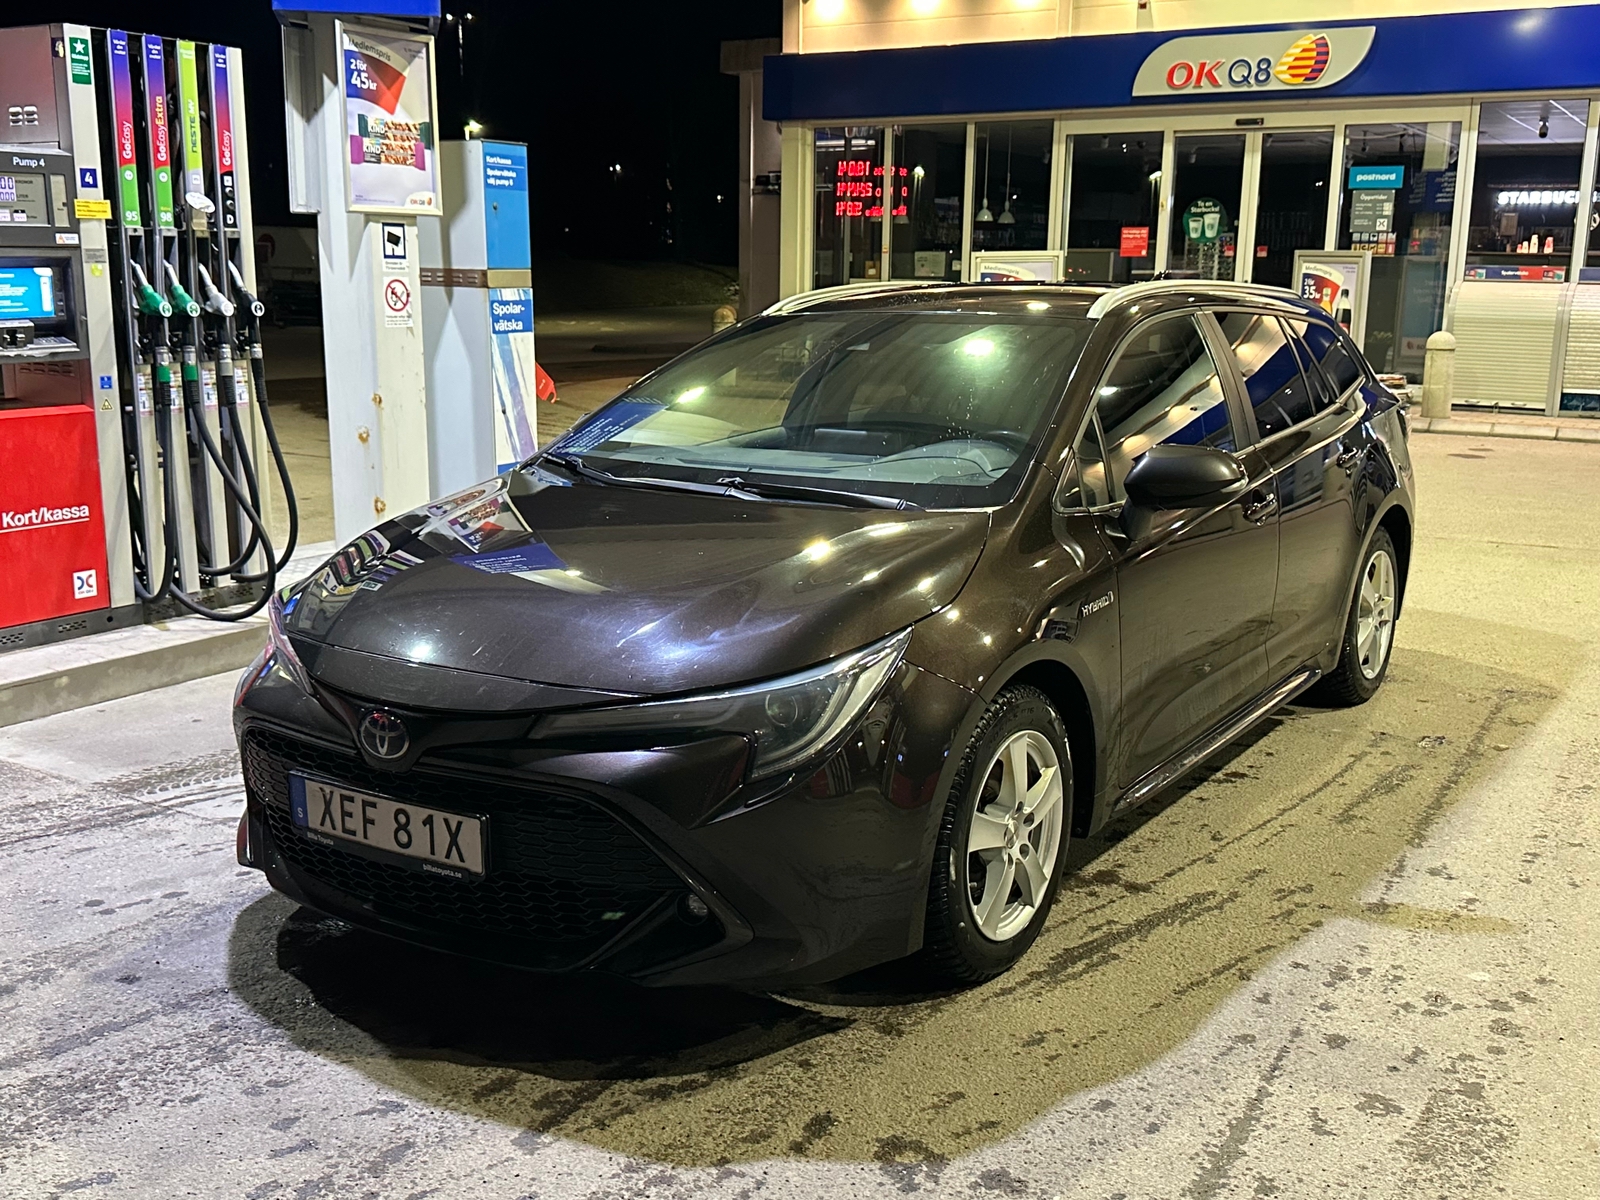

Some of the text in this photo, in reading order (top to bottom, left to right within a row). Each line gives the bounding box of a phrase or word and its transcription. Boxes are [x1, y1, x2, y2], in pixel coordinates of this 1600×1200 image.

[350, 58, 367, 71] 2 för
[155, 95, 168, 162] GoEasyExtra
[190, 116, 198, 153] NESTE
[122, 120, 132, 159] GoEasy
[222, 129, 232, 166] GoEasy
[363, 144, 381, 154] KIND
[12, 156, 45, 168] Pump 4
[84, 171, 94, 185] 4
[1356, 173, 1396, 182] postnord
[125, 211, 138, 221] 95
[160, 212, 173, 222] 98
[226, 214, 234, 224] D
[492, 302, 525, 316] Spolar-
[494, 318, 523, 331] vätska
[2, 504, 90, 528] Kort/kassa
[297, 806, 303, 818] S
[319, 786, 466, 864] XEF 81X
[318, 834, 335, 846] Toyota
